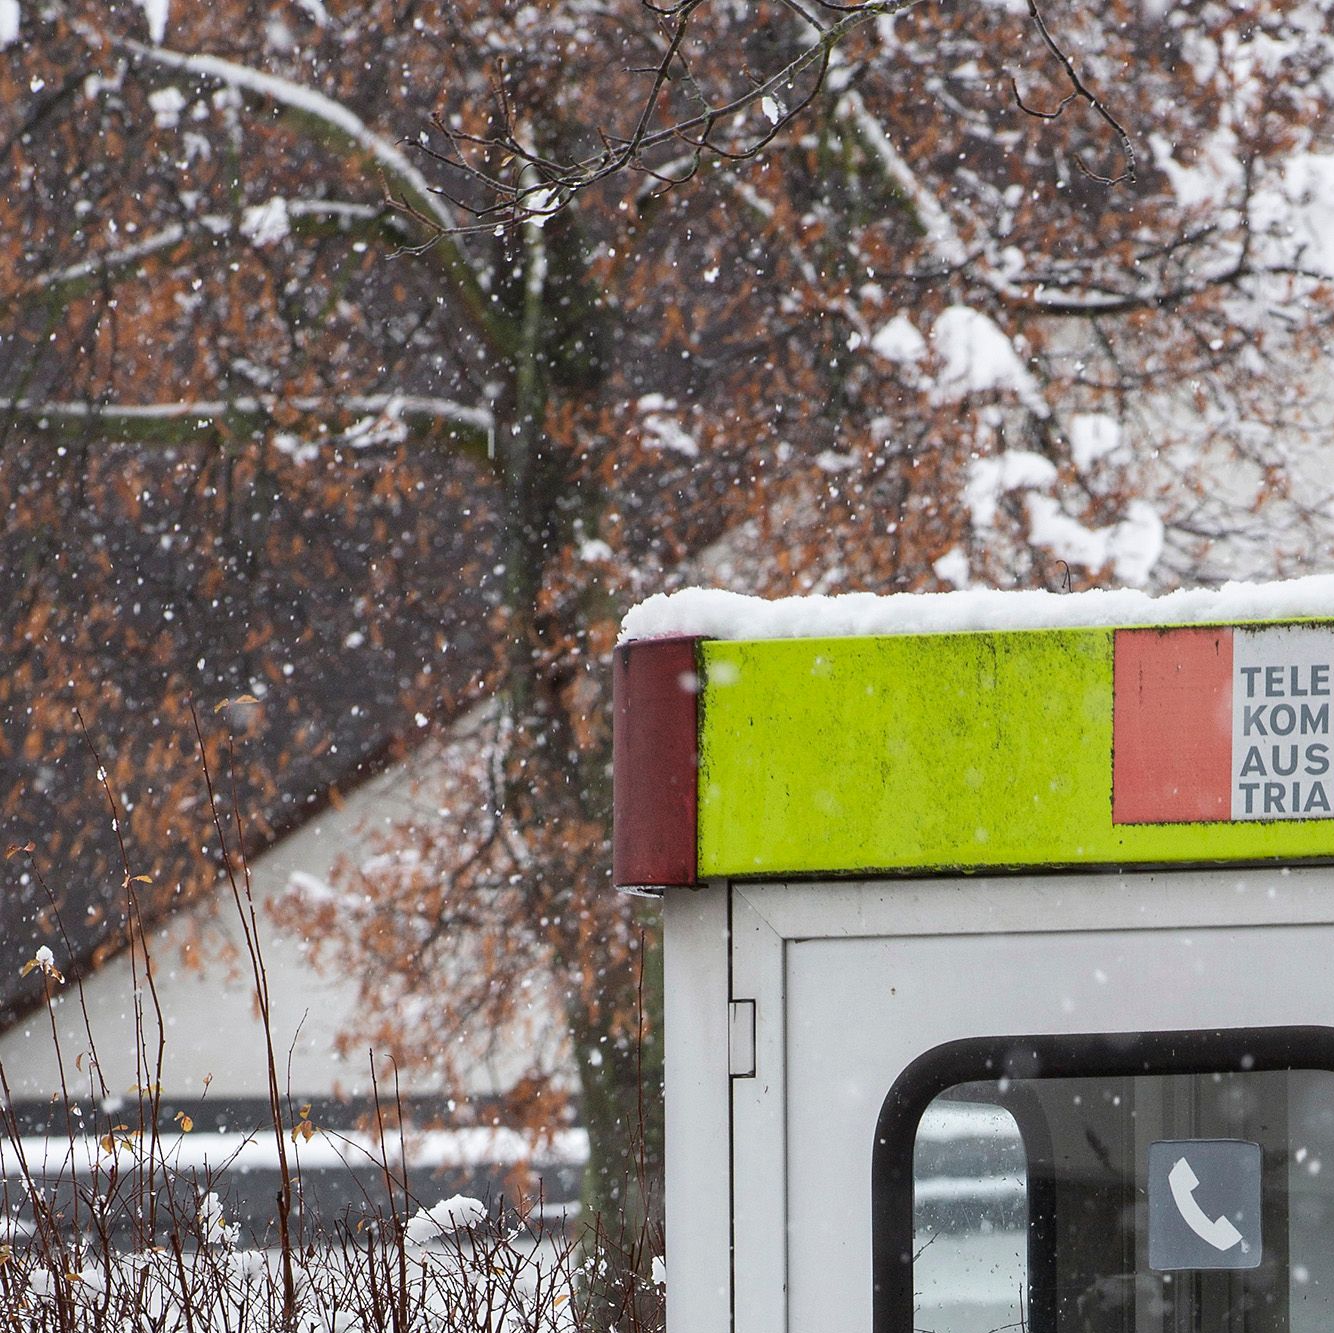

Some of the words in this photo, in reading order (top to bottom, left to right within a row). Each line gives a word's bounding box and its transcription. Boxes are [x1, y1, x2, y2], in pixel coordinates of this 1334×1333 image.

[1240, 665, 1330, 697] TELE
[1243, 703, 1329, 736] KOM
[1240, 743, 1330, 776] AUS
[1239, 781, 1331, 813] TRIA
